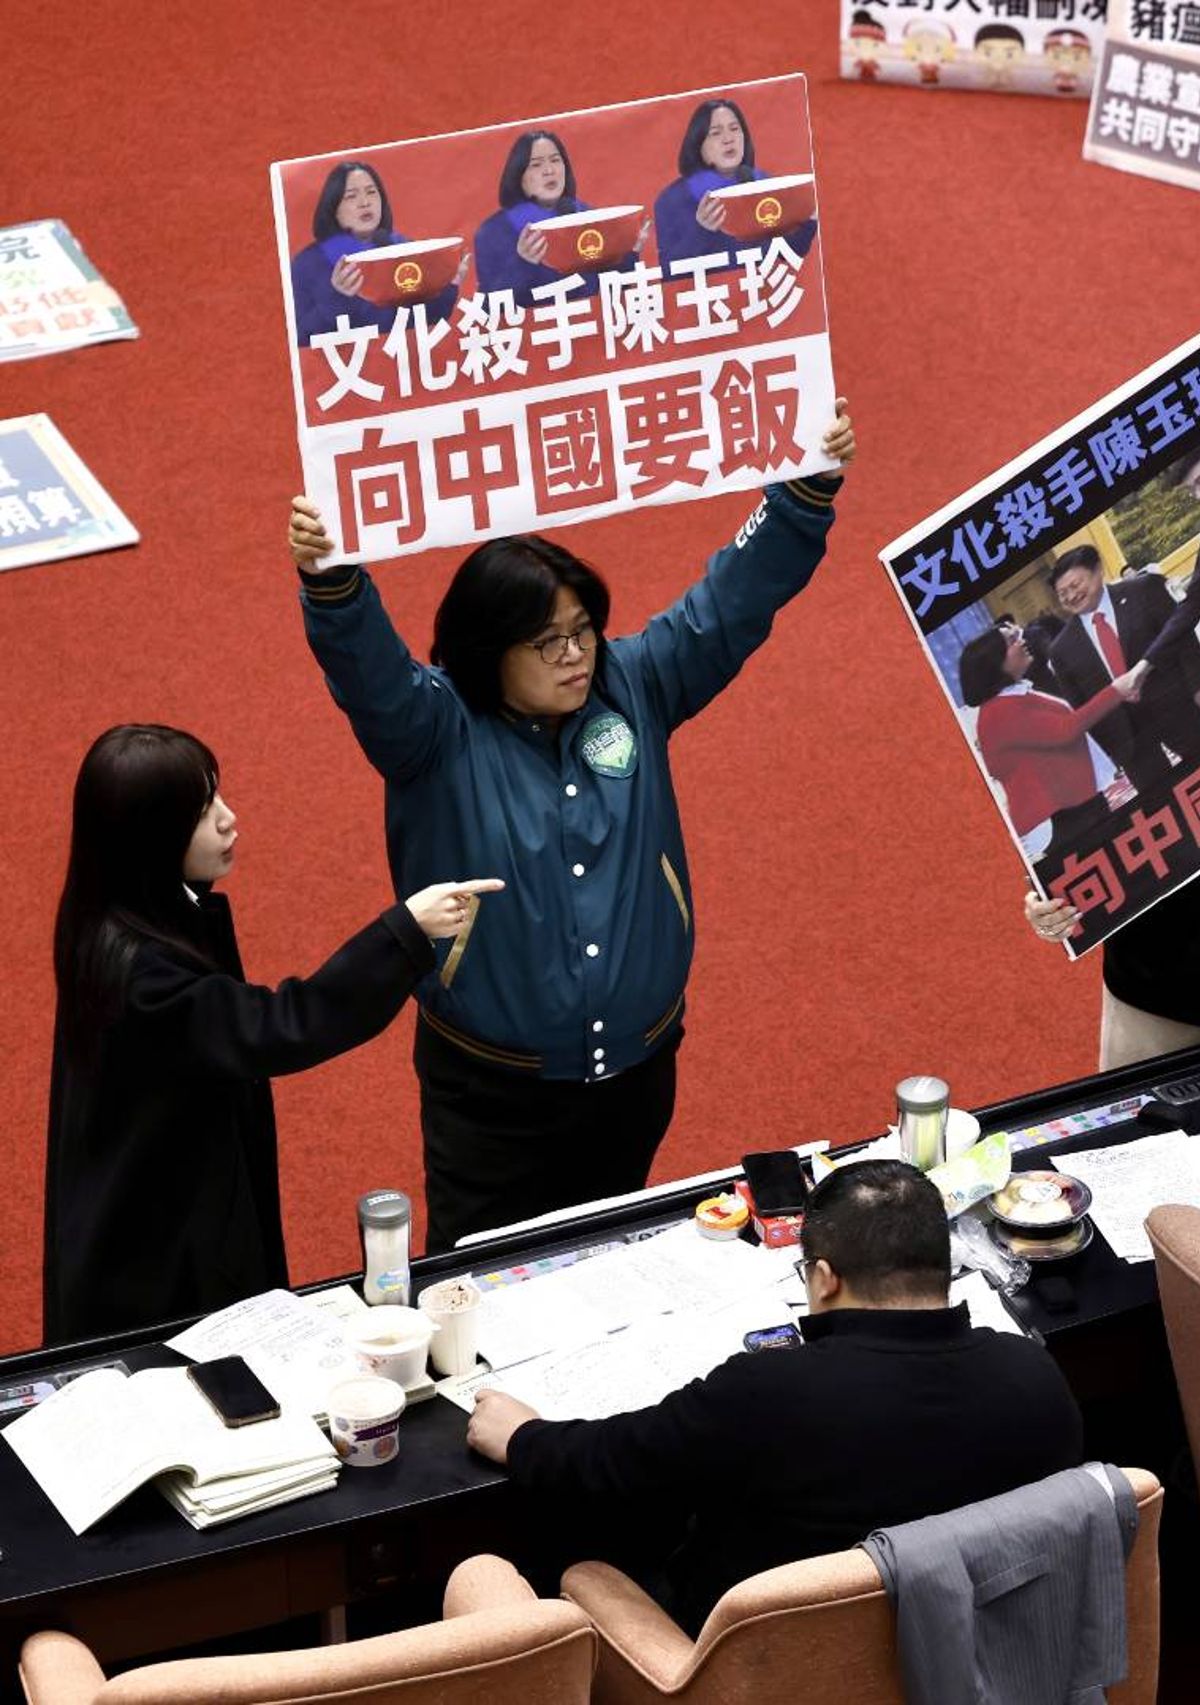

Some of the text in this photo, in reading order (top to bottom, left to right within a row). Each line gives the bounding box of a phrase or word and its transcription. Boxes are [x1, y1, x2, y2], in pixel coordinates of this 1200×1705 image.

[309, 236, 805, 413] 文化殺手陳玉珍
[333, 353, 807, 555] 向中國要飯
[735, 495, 768, 549] 202
